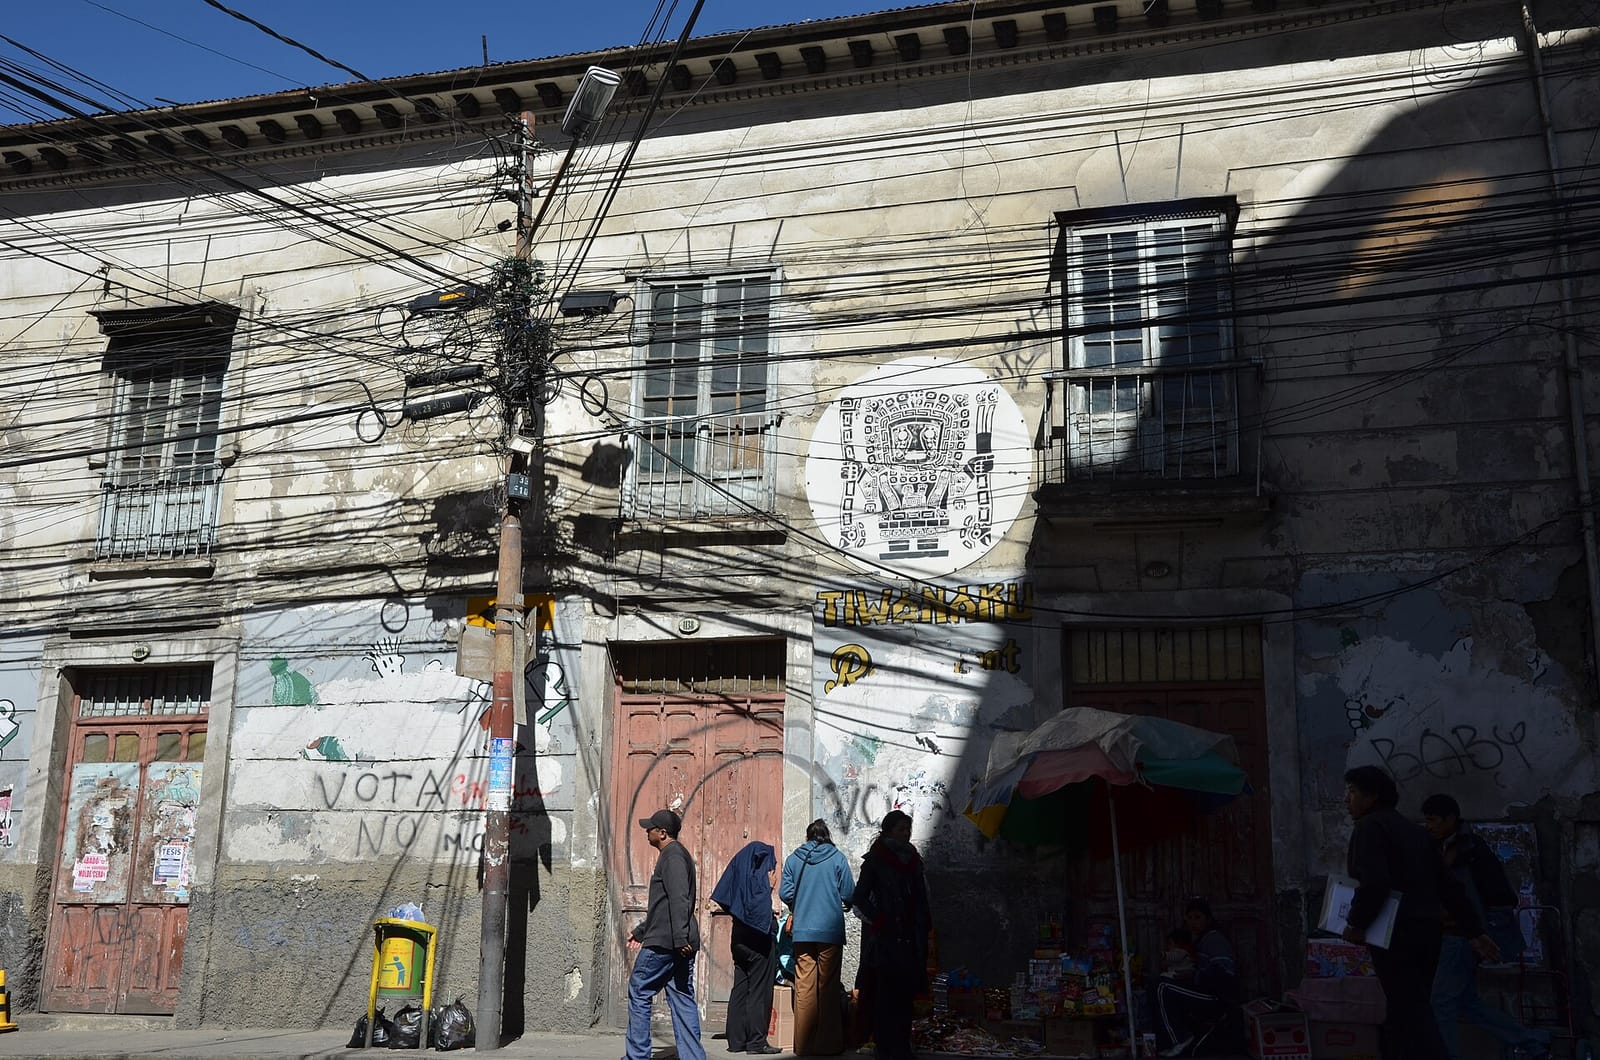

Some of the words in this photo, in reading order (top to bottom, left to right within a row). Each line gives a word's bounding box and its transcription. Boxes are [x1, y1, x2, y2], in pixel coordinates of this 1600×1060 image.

[1370, 721, 1533, 782] BABY
[317, 769, 445, 810] VOTA
[162, 848, 182, 856] TESIS
[355, 815, 416, 857] NO
